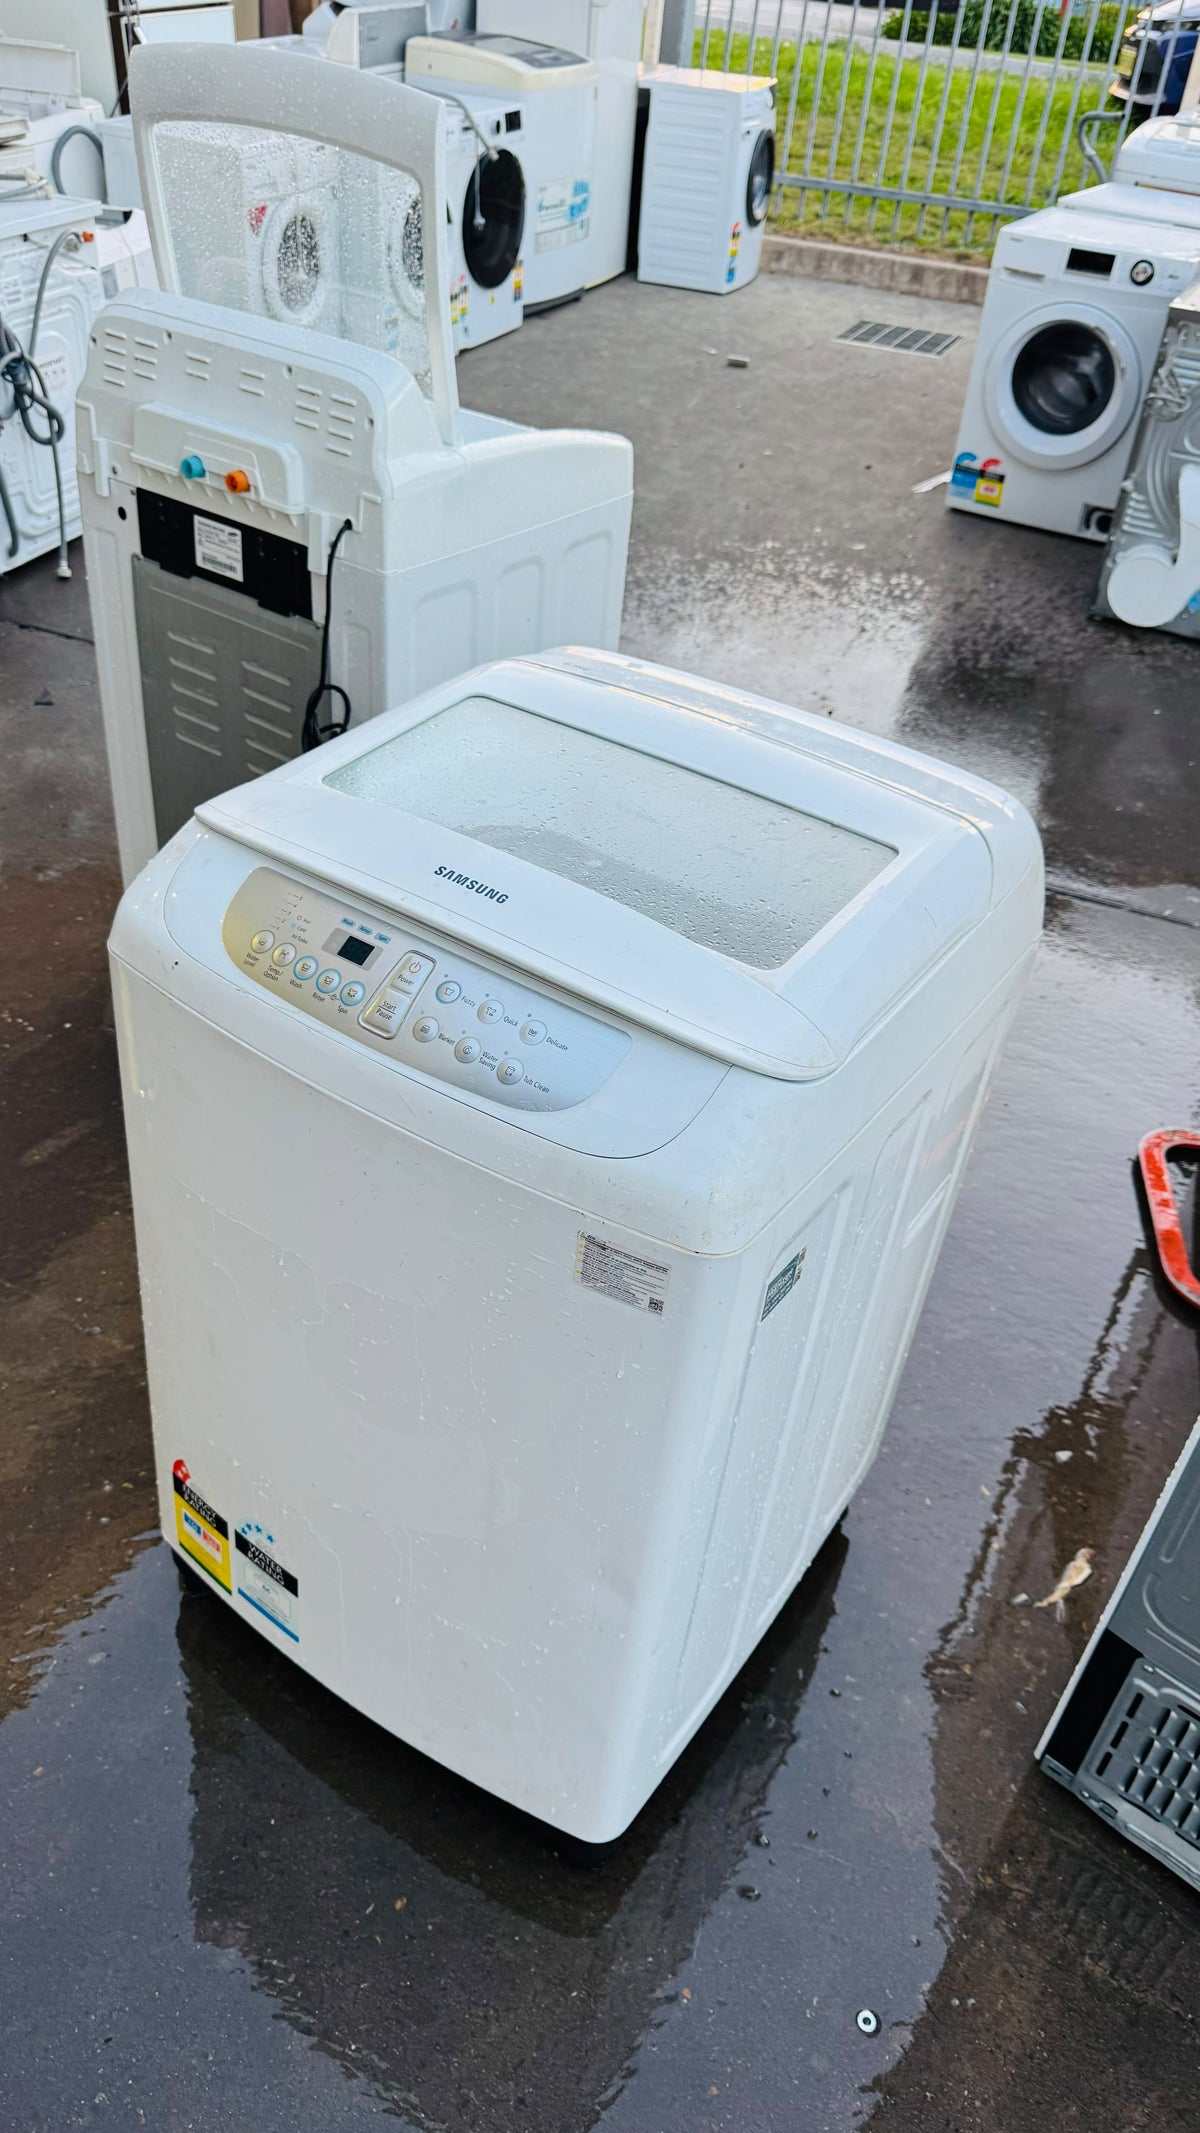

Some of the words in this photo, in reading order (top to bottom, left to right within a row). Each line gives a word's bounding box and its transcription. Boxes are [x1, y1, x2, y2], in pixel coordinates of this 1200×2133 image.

[434, 865, 509, 904] SAMSUNG
[263, 970, 279, 981] Option
[397, 974, 416, 986] Power
[289, 978, 303, 989] Wash
[312, 991, 326, 1003] Rinse
[461, 996, 477, 1008] Fuzzy
[337, 1004, 348, 1014] Spin
[382, 1000, 397, 1012] Start
[375, 1008, 393, 1021] Pause
[503, 1015, 518, 1027] Quick
[438, 1033, 456, 1046] Blanket
[546, 1036, 568, 1051] Delicate
[482, 1050, 499, 1062] Water
[479, 1057, 496, 1071] Saving
[523, 1075, 534, 1086] Tub
[533, 1081, 550, 1094] Clean
[248, 1542, 283, 1576] WATER
[247, 1550, 285, 1585] RATING
